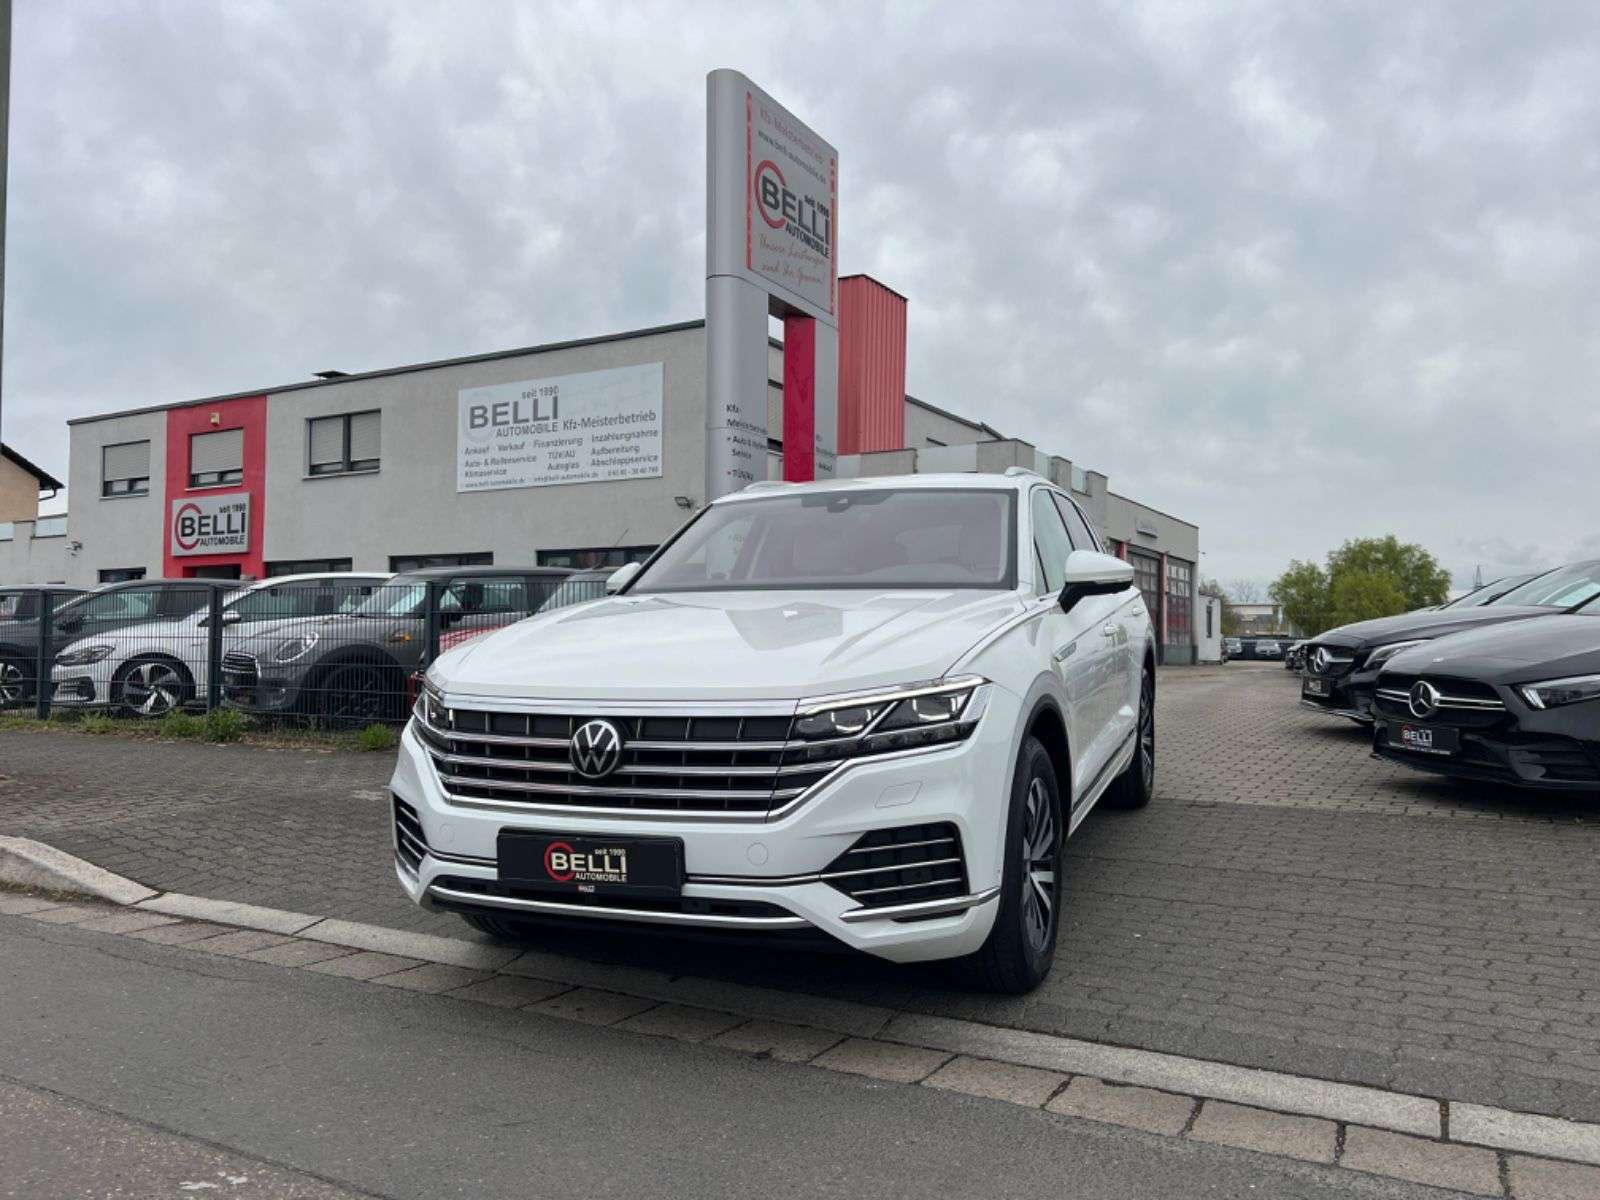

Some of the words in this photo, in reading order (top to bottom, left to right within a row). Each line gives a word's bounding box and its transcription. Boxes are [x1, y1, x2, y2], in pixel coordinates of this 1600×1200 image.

[762, 175, 830, 246] BELLI
[785, 218, 830, 259] AUTOMOBILE
[522, 389, 537, 399] seit
[469, 396, 559, 429] BELLI
[496, 421, 558, 438] AUTOMOBILE
[563, 410, 657, 431] Kfz-Meisterbetrieb
[533, 436, 584, 449] Finanzierung
[181, 512, 246, 537] BELLI
[200, 534, 246, 546] AUTOMOBILE
[551, 851, 627, 873] BELLI
[575, 872, 627, 882] AUTOMOBILE
